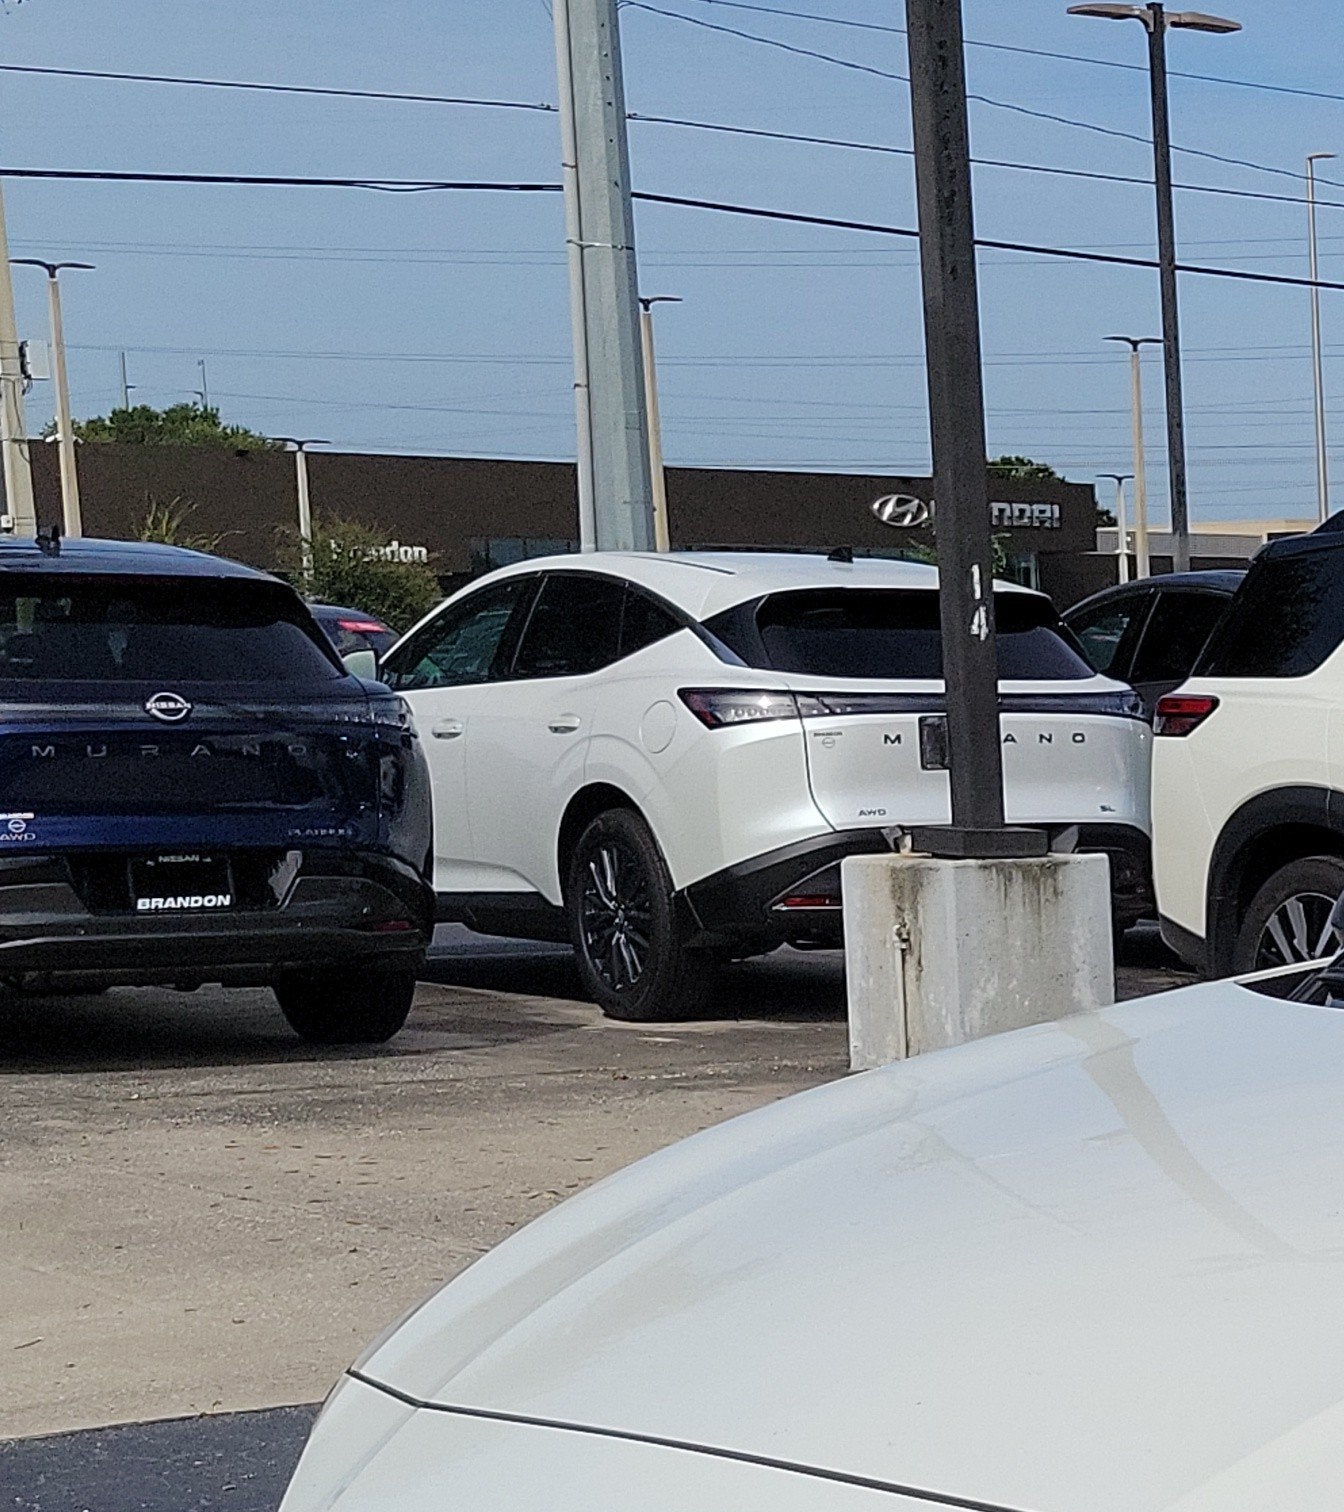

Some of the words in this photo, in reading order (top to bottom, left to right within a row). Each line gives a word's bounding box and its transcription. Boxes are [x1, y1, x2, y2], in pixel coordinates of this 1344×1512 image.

[929, 499, 1060, 528] NDAI
[883, 732, 1086, 745] MANO
[31, 744, 307, 757] MURANO
[858, 808, 887, 817] AWD
[0, 832, 36, 841] AWD
[158, 855, 200, 863] NISSAN
[136, 894, 231, 910] BRANDON
